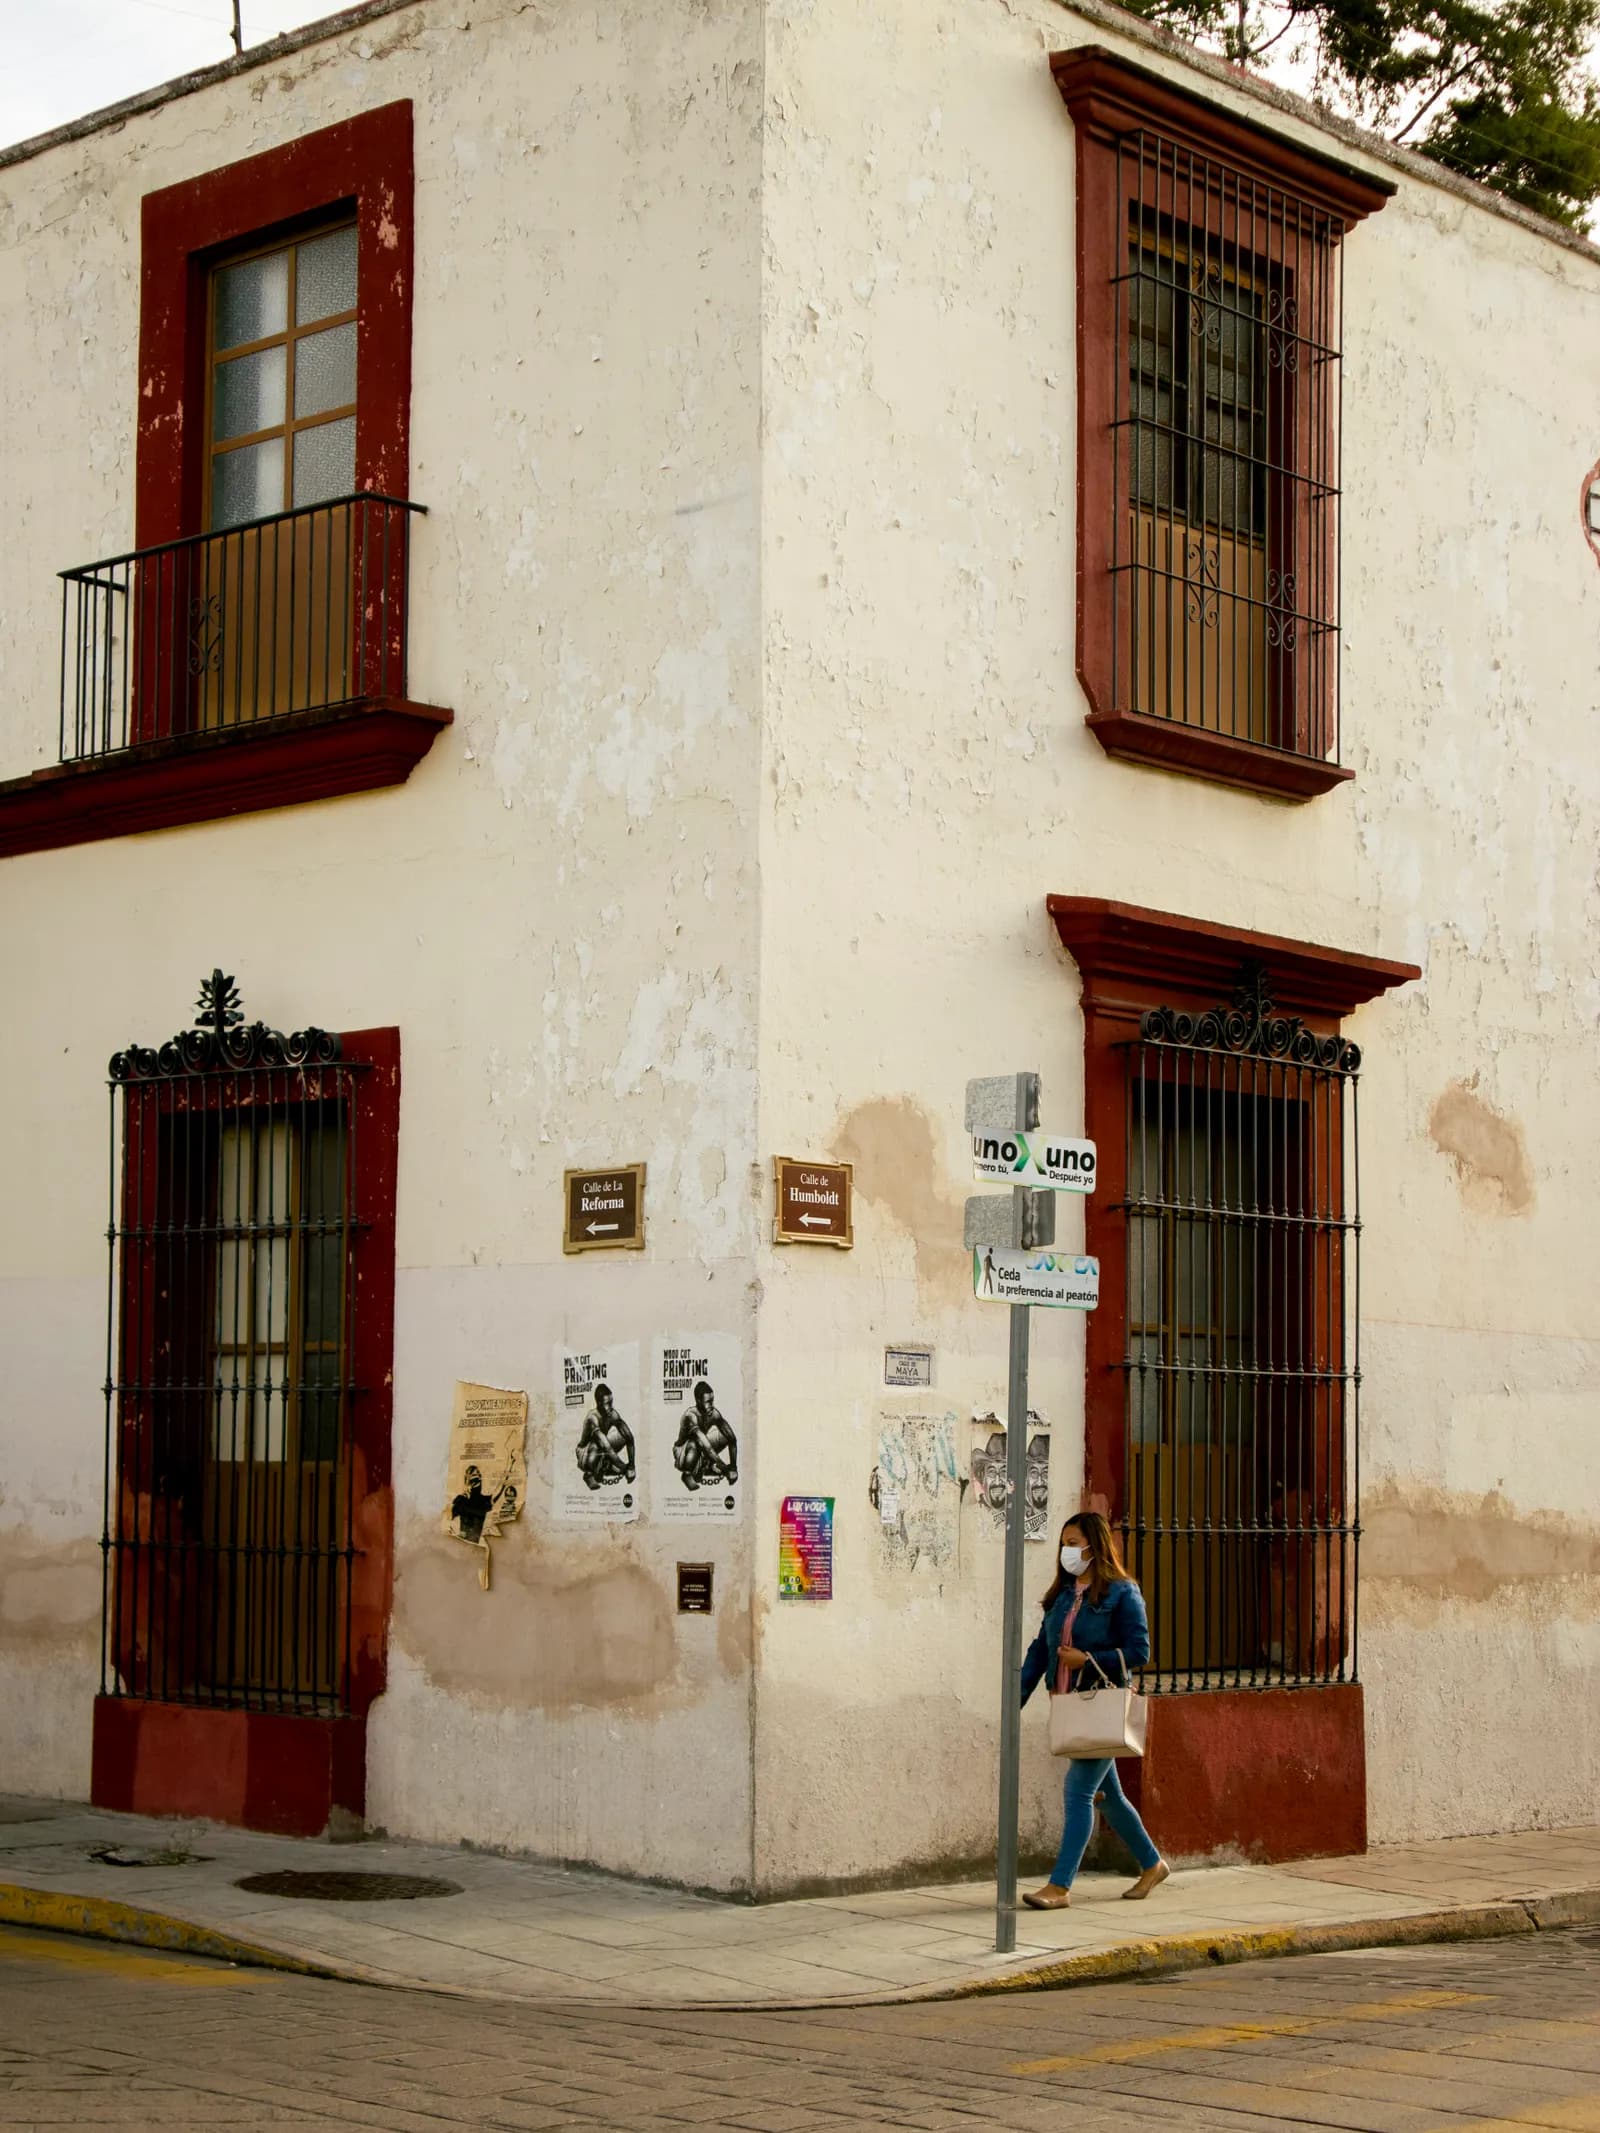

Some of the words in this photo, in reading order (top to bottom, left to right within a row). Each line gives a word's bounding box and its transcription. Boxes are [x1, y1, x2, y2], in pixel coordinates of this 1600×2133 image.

[974, 1137, 1017, 1162] uno
[1046, 1147, 1095, 1172] uno
[800, 1173, 819, 1185] Calle
[820, 1175, 829, 1186] de
[1049, 1170, 1082, 1184] Después
[1083, 1175, 1094, 1186] yo
[582, 1181, 601, 1193] Calle
[602, 1180, 612, 1192] de
[613, 1180, 623, 1191] La
[790, 1187, 839, 1205] Humboldt
[581, 1196, 624, 1211] Reforma
[998, 1267, 1021, 1281] Ceda
[998, 1283, 1005, 1293] la
[1006, 1285, 1054, 1298] preferencia
[1055, 1288, 1064, 1298] al
[1066, 1290, 1098, 1303] peatón
[580, 1355, 591, 1365] CUT
[680, 1349, 691, 1359] CUT
[896, 1366, 918, 1376] MAYA
[565, 1382, 593, 1394] WORKSHOP
[663, 1379, 692, 1389] WORKSHOP
